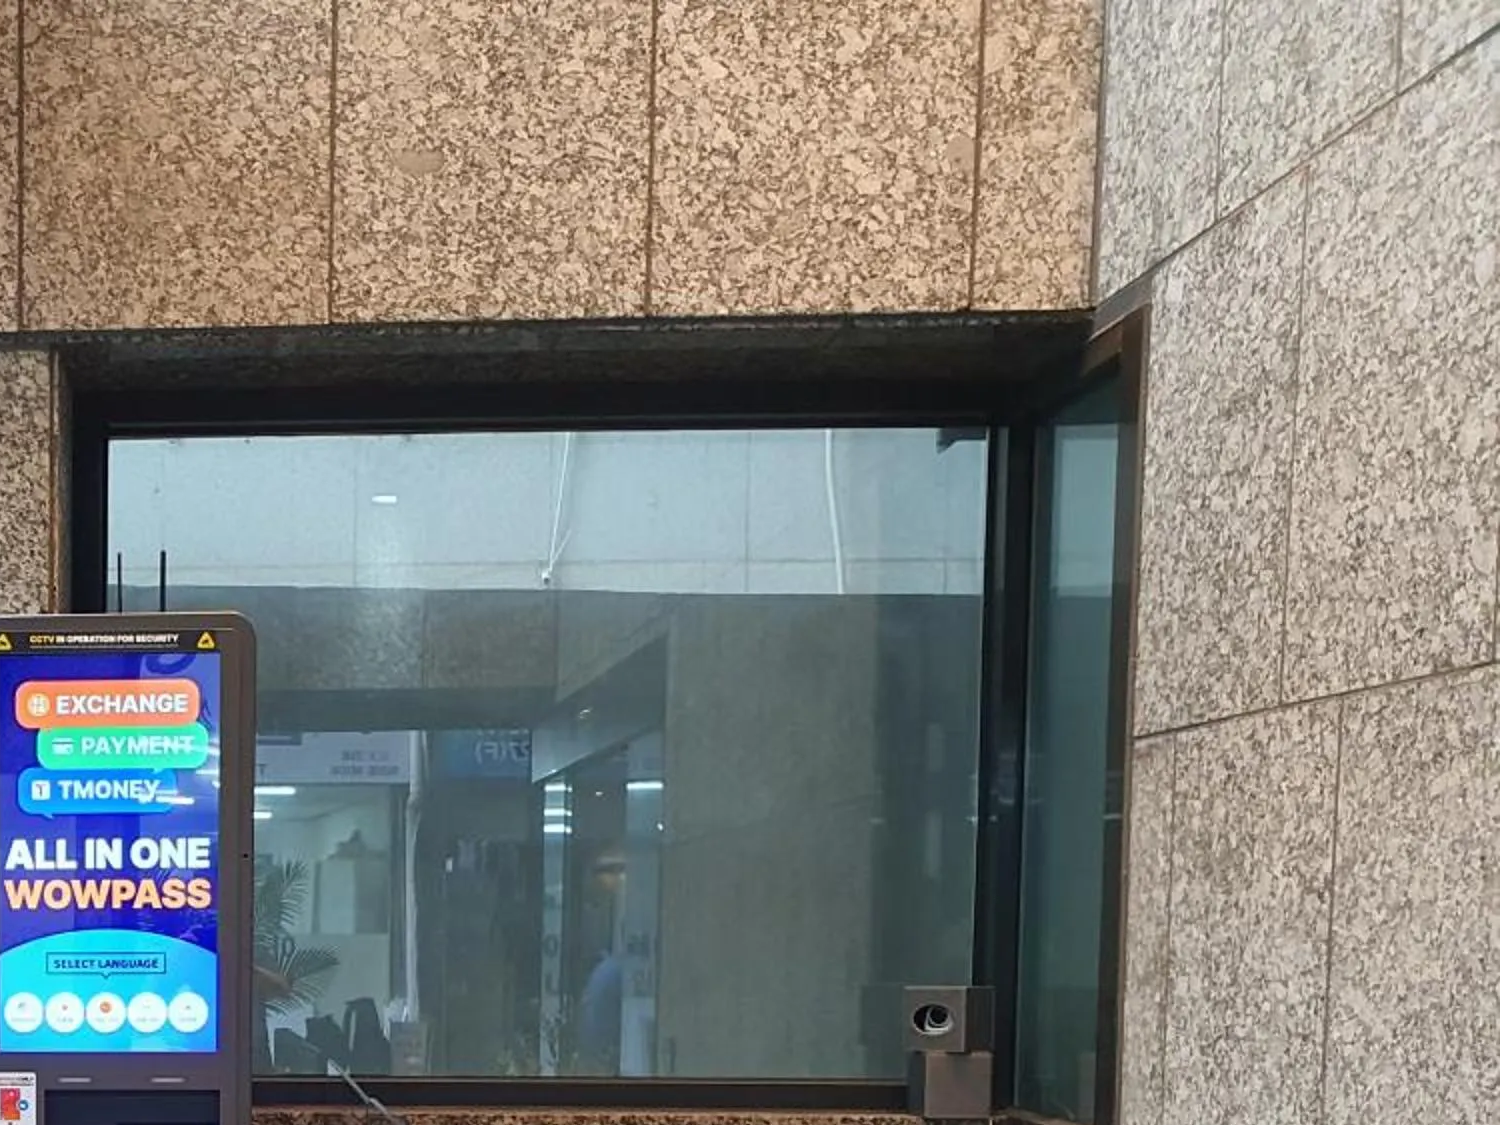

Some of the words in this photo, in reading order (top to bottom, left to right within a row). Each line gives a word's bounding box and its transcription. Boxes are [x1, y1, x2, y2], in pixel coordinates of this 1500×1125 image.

[29, 635, 55, 643] CCTV
[66, 635, 116, 643] OPERATION
[117, 634, 135, 643] FOR
[136, 634, 179, 643] SECURITY
[56, 693, 189, 714] EXCHANGE
[81, 735, 195, 755] PAYMENT
[57, 779, 160, 800] TMONEY
[5, 840, 77, 870] ALL
[84, 839, 125, 869] IN
[130, 837, 211, 869] ONE
[4, 879, 211, 910] WOWPASS
[54, 959, 95, 969] SELECT
[98, 958, 159, 969] LANGUAGE
